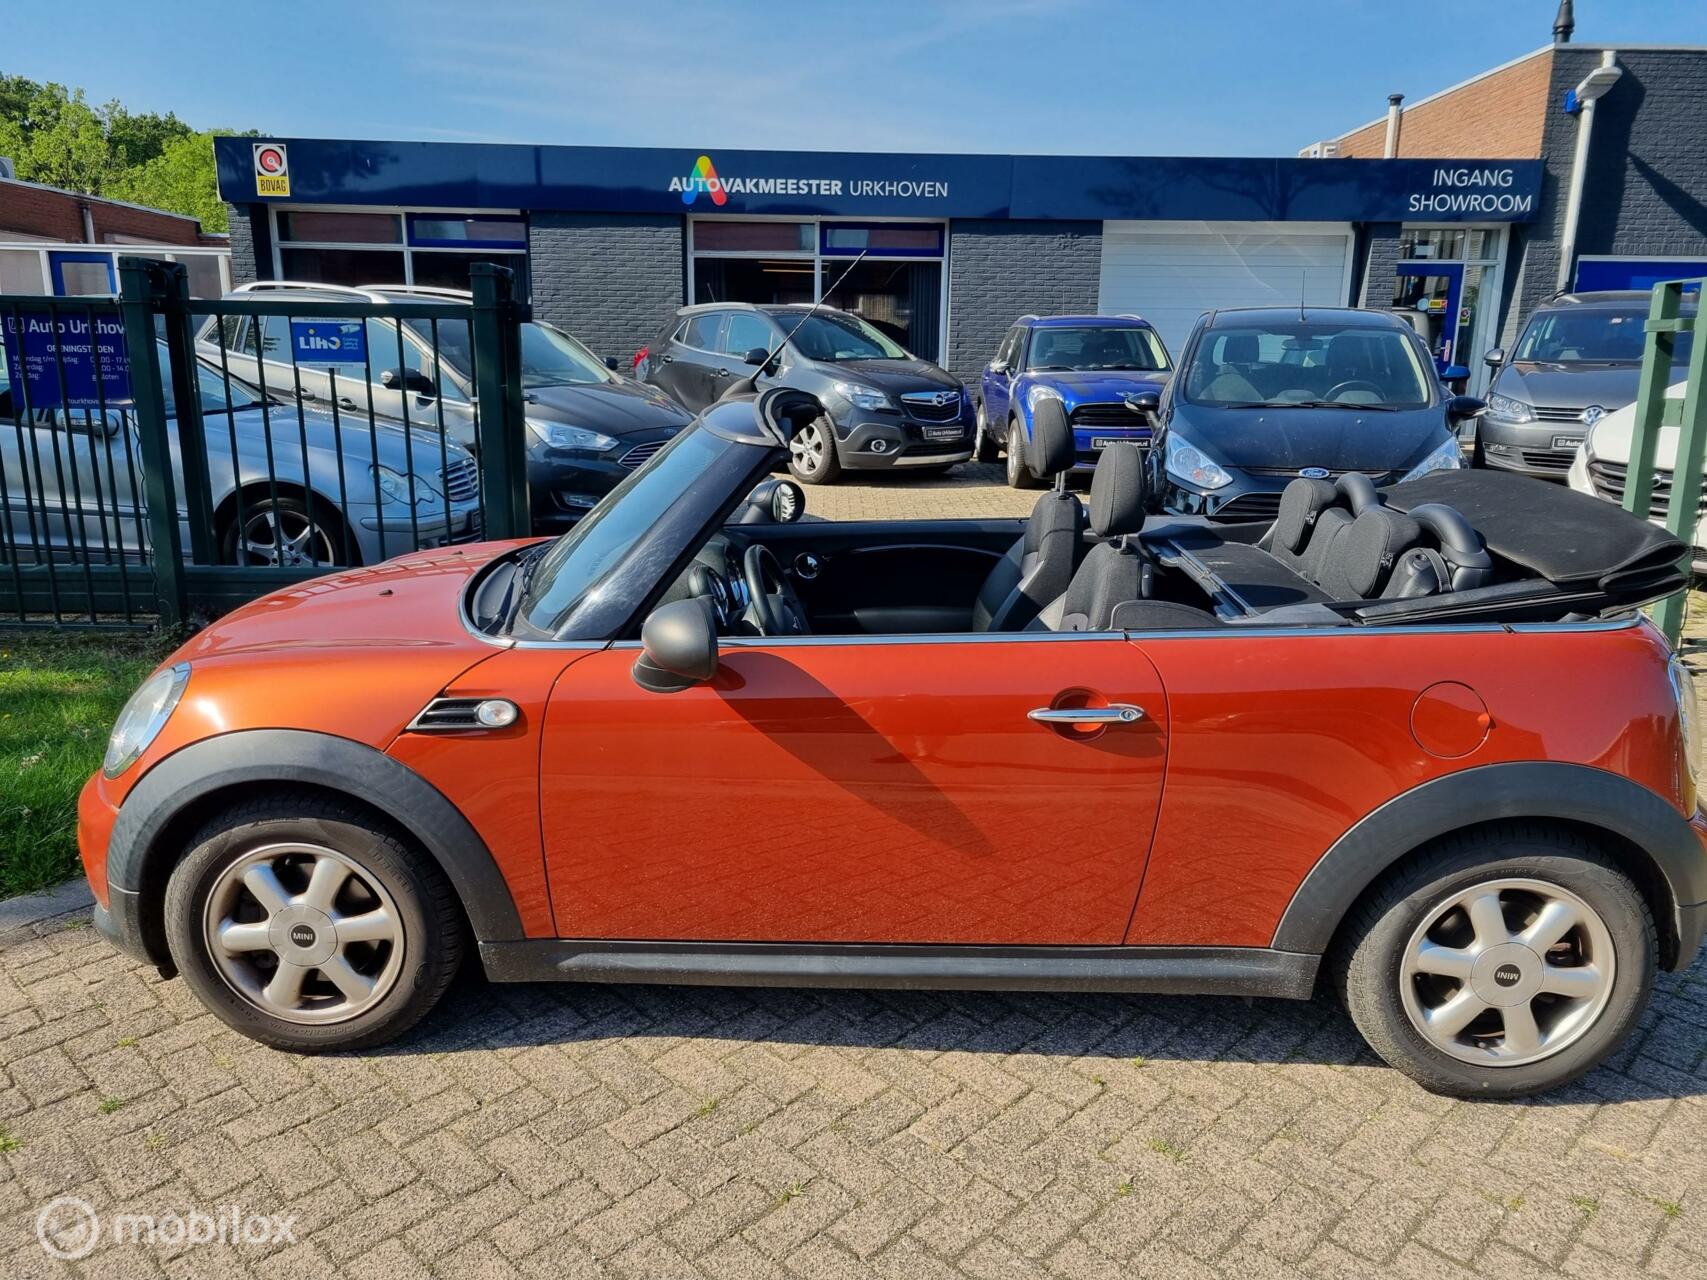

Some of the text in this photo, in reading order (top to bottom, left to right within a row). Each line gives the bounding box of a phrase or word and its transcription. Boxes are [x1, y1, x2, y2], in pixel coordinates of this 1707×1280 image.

[260, 179, 286, 192] BOVAG
[1432, 169, 1514, 187] INGANG
[668, 176, 949, 197] AUTOVAKMEESTER URKHOVEN
[1408, 194, 1532, 212] SHOWROOM
[293, 931, 313, 941] MINI
[1497, 971, 1519, 980] MINI
